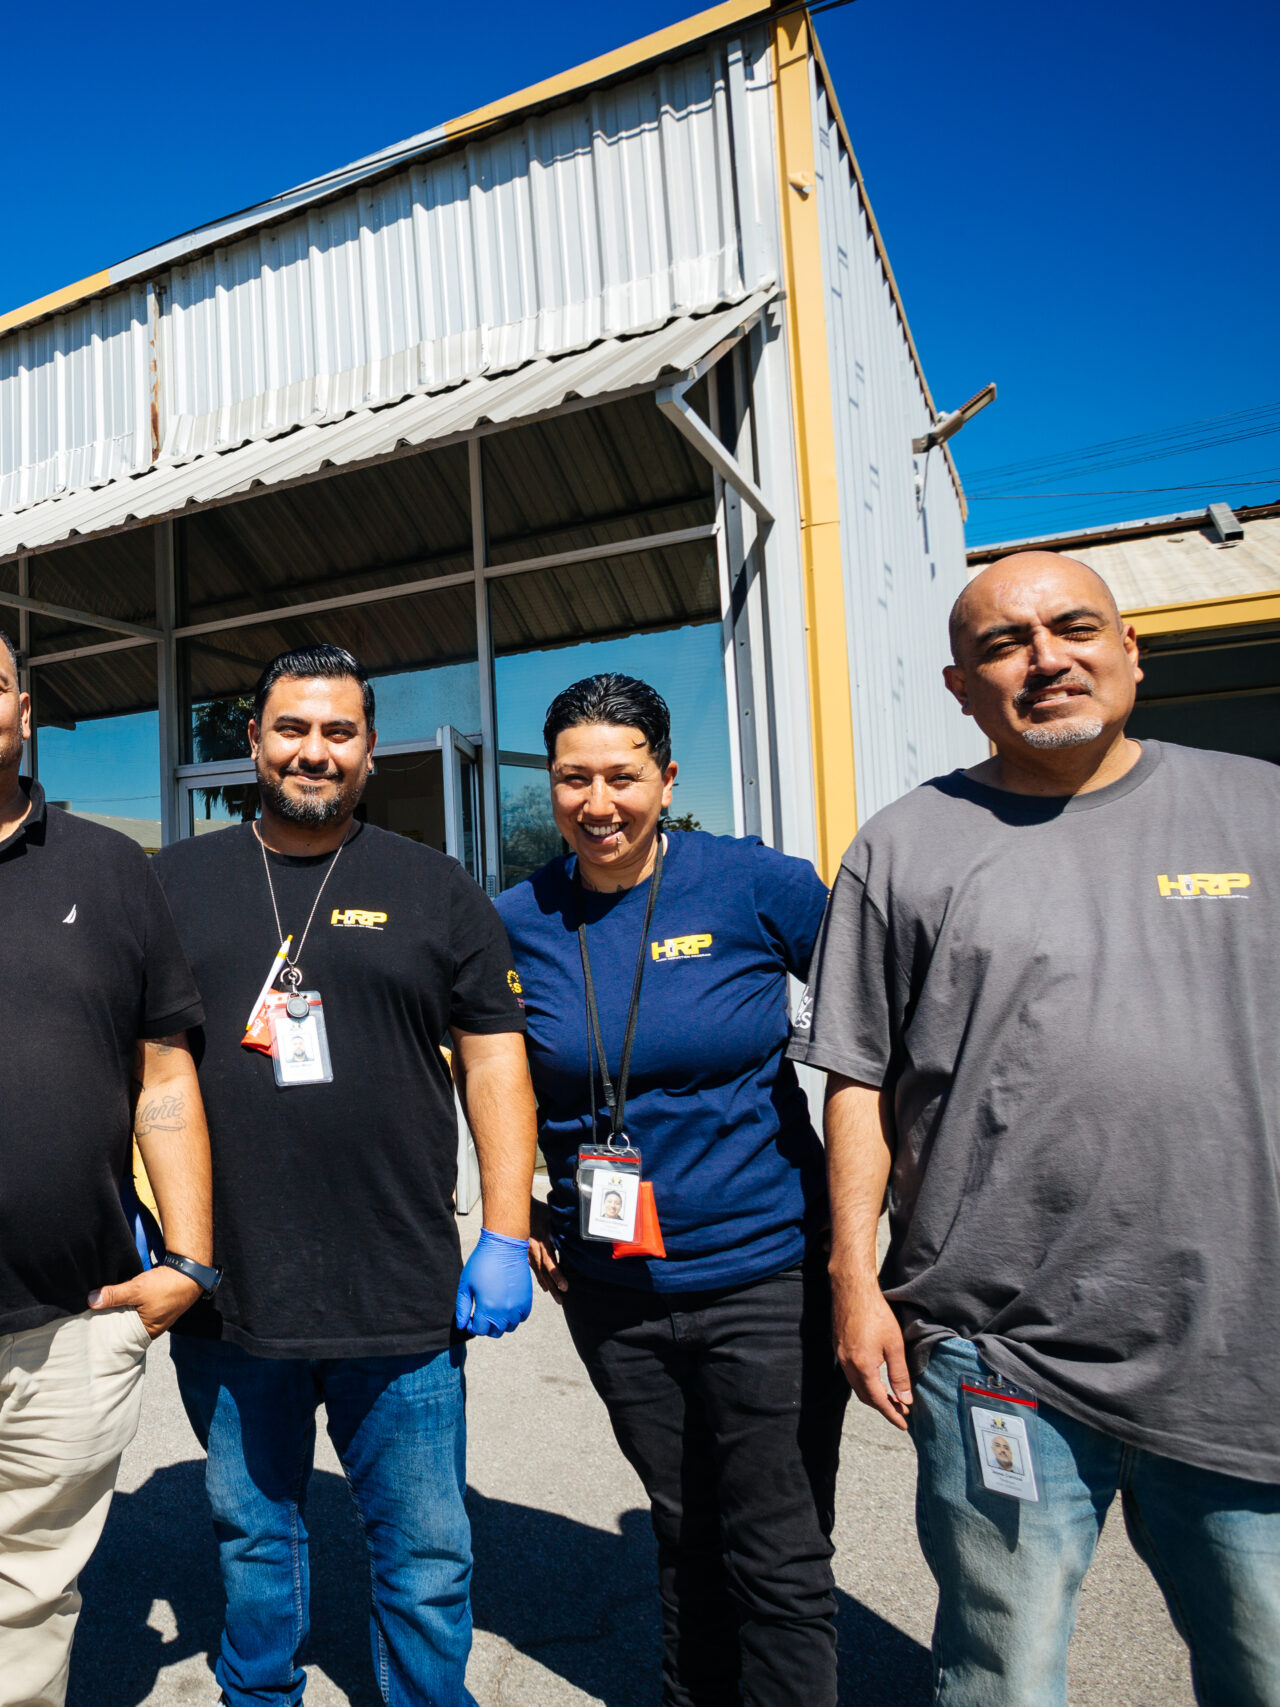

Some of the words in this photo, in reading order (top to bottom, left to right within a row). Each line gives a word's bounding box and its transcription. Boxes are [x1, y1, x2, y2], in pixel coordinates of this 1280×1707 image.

[1156, 872, 1251, 897] HRP
[330, 908, 388, 926] HRP
[651, 933, 713, 960] HRP
